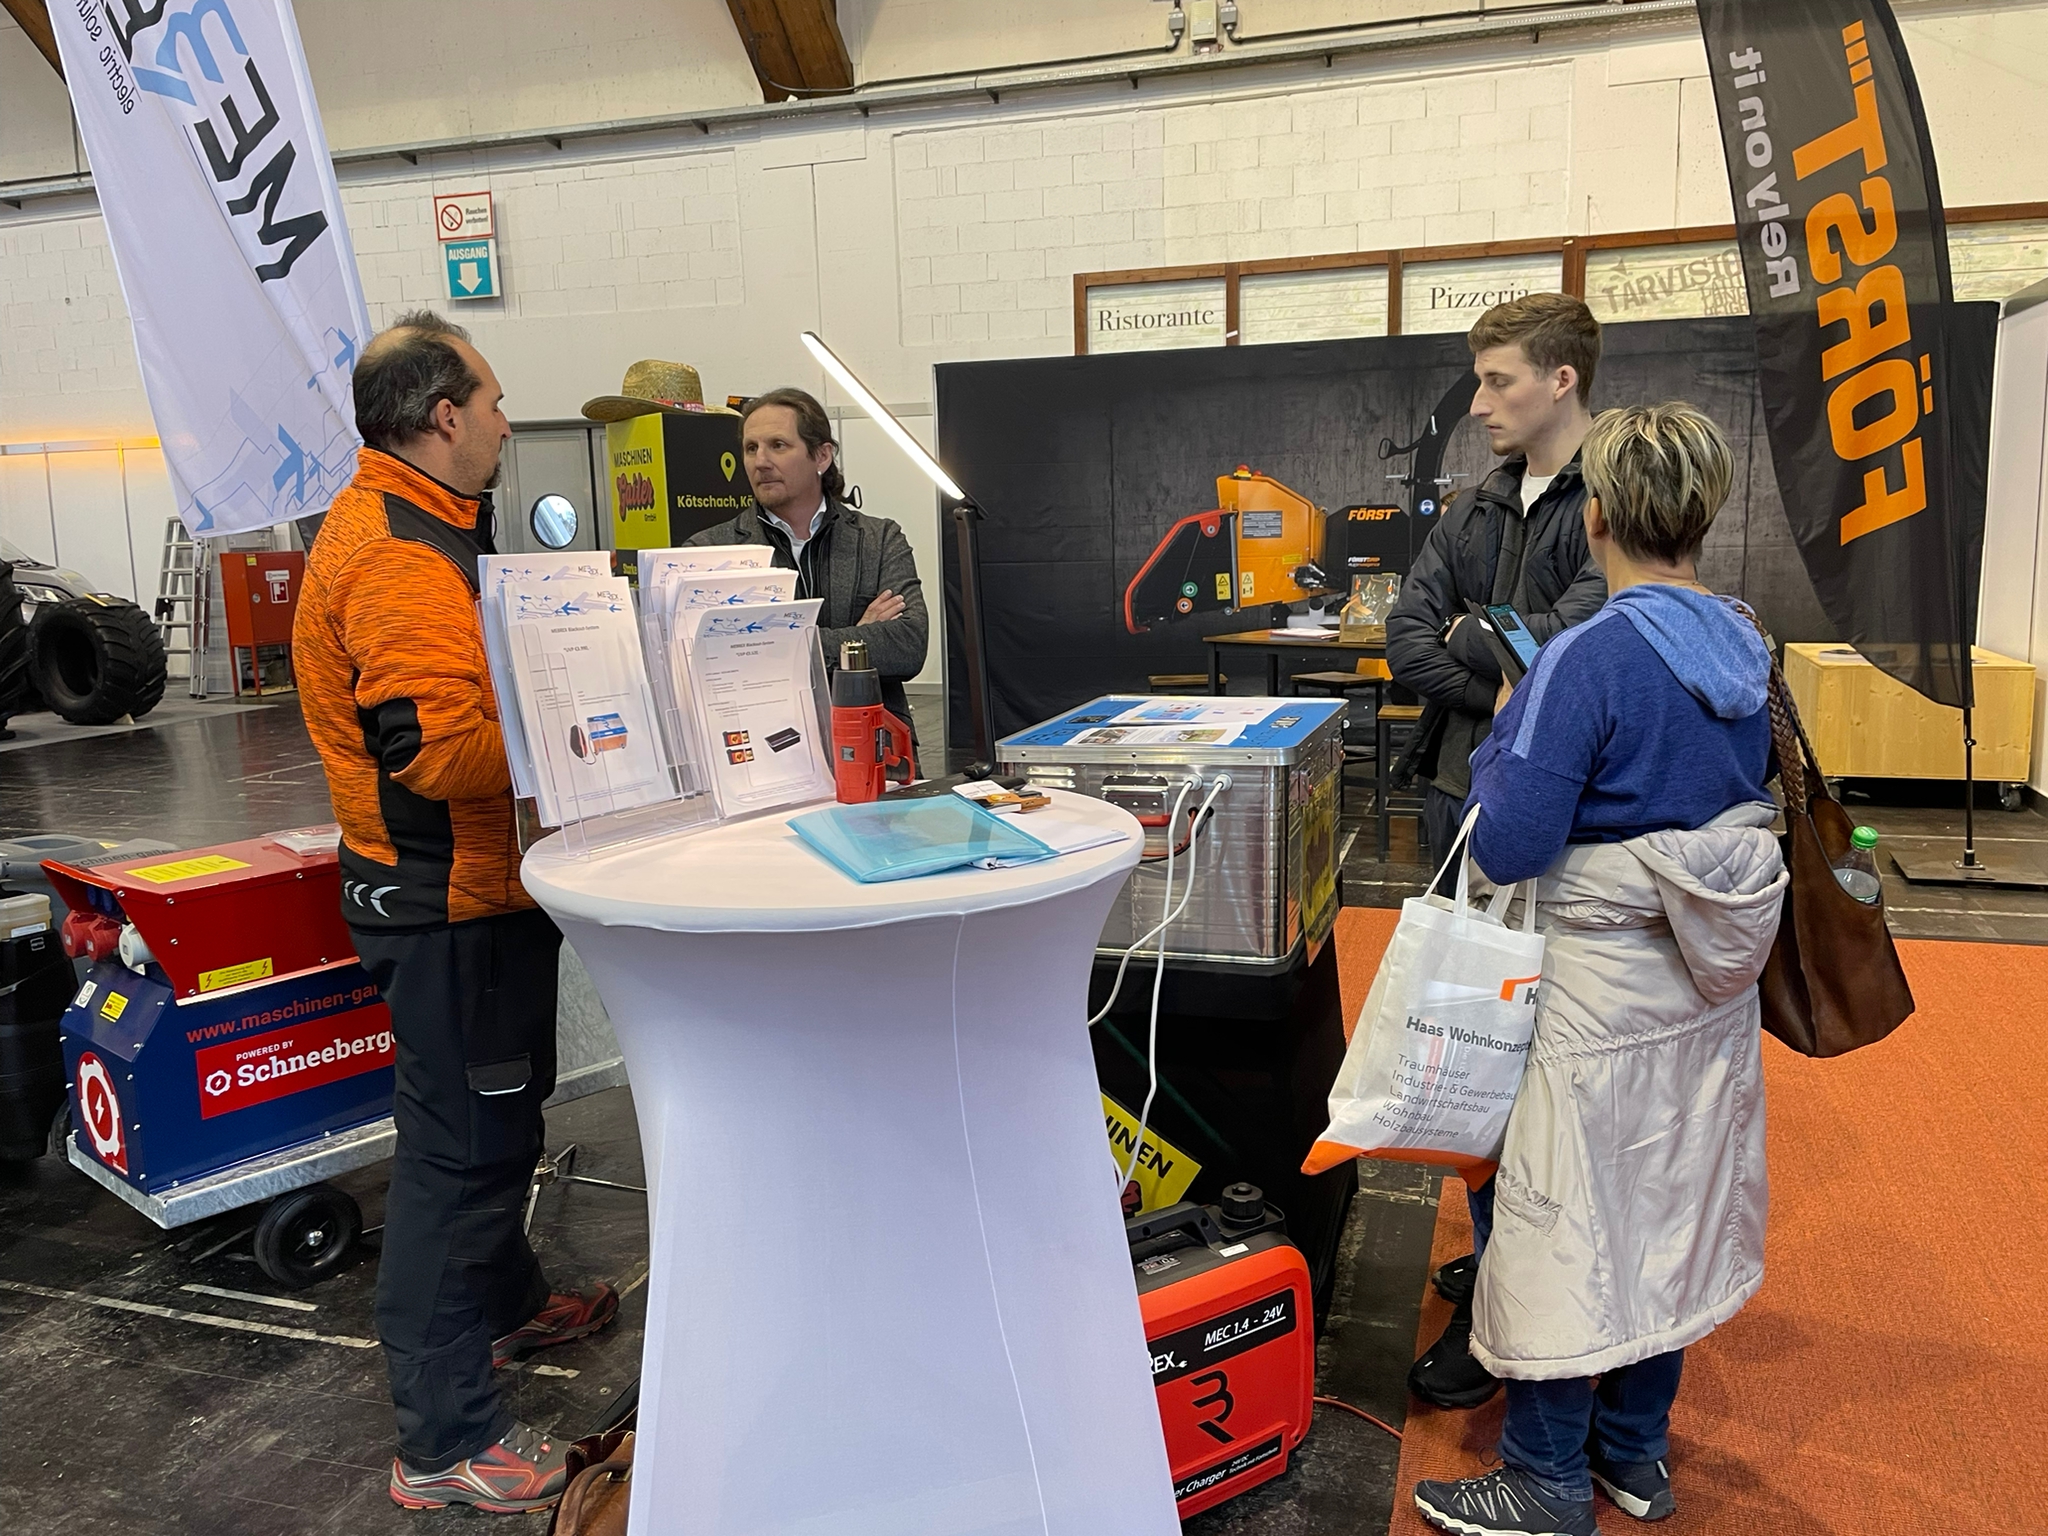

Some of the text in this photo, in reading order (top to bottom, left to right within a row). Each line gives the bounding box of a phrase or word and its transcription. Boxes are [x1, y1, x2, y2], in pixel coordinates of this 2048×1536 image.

[448, 246, 488, 261] AUSGANG
[1098, 308, 1215, 331] Ristorante
[613, 447, 653, 468] MASCHINEN
[677, 495, 739, 510] Kötschach,
[1347, 507, 1401, 521] FÖRST
[1405, 1015, 1445, 1037] Haas
[236, 1039, 294, 1061] POWERED BY
[1398, 1053, 1471, 1080] Traumhäuser
[1392, 1069, 1447, 1093] Industrie-
[1449, 1082, 1459, 1095] &
[1382, 1098, 1434, 1122] Wohnbau
[1389, 1085, 1491, 1114] Landwirtschaftsbau
[1372, 1113, 1460, 1139] Holzbausysteme
[1204, 1325, 1232, 1347] MEC
[1234, 1317, 1249, 1335] 1.4
[1262, 1303, 1285, 1323] 24V
[1185, 1468, 1227, 1494] Charger
